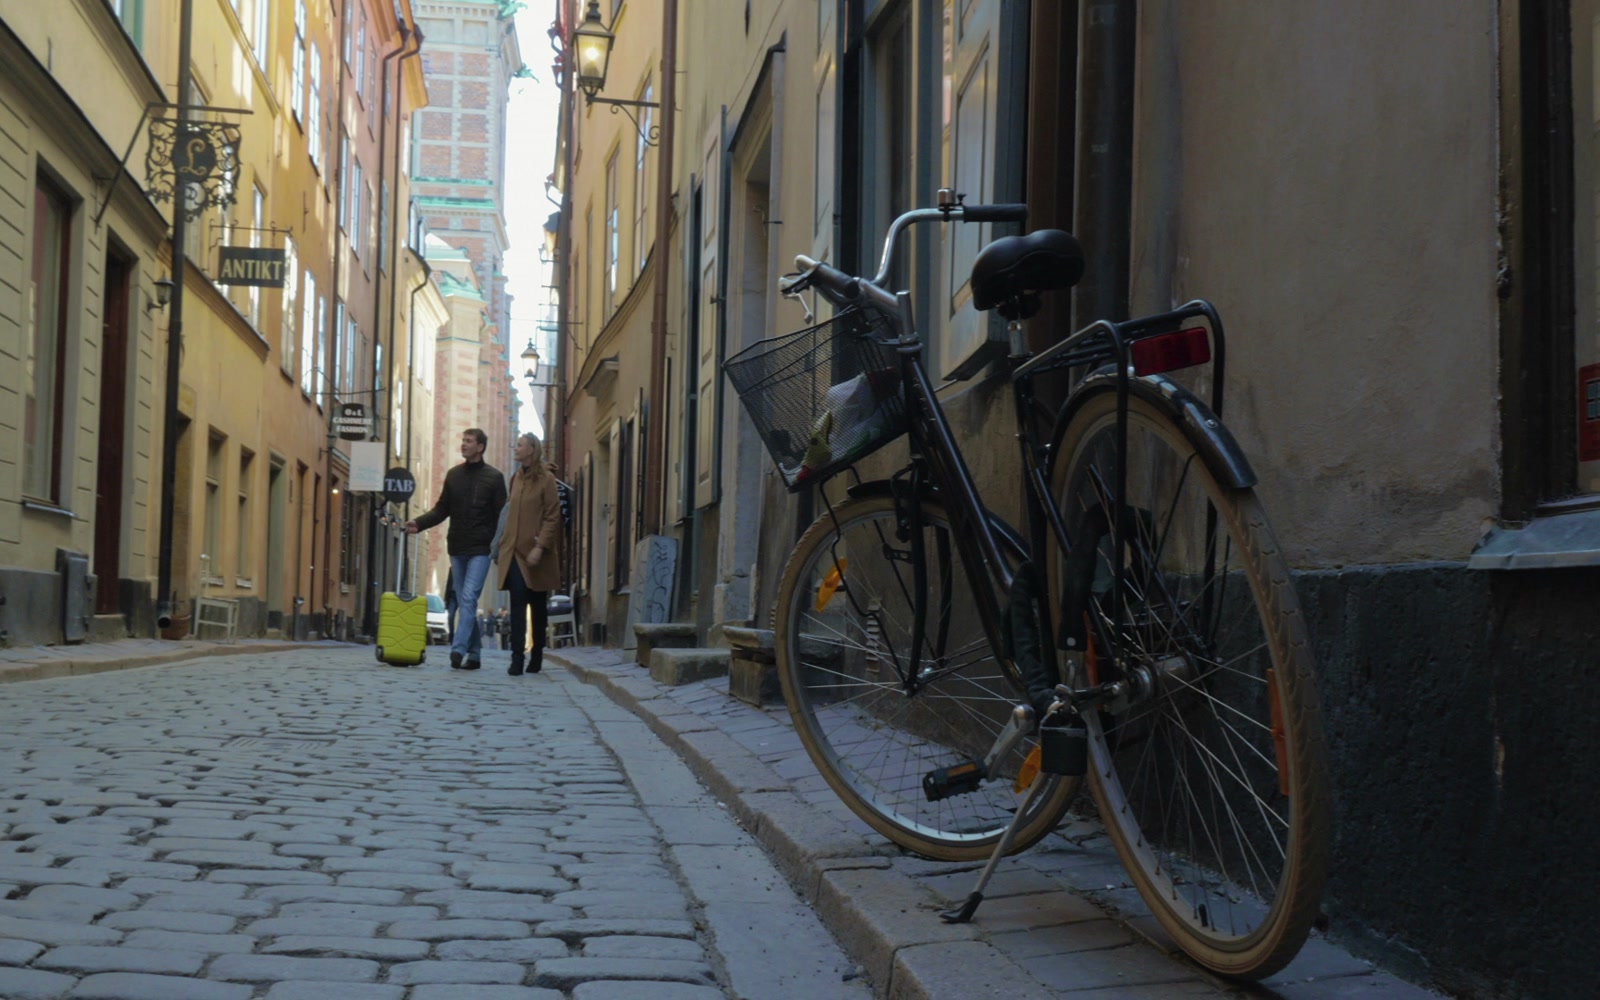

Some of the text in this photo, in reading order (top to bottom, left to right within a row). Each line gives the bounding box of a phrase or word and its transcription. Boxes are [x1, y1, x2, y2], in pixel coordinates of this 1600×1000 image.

[221, 259, 282, 280] ANTIKT
[332, 417, 373, 425] CASHMERE
[336, 425, 368, 433] FASHION
[385, 478, 413, 492] TAB
